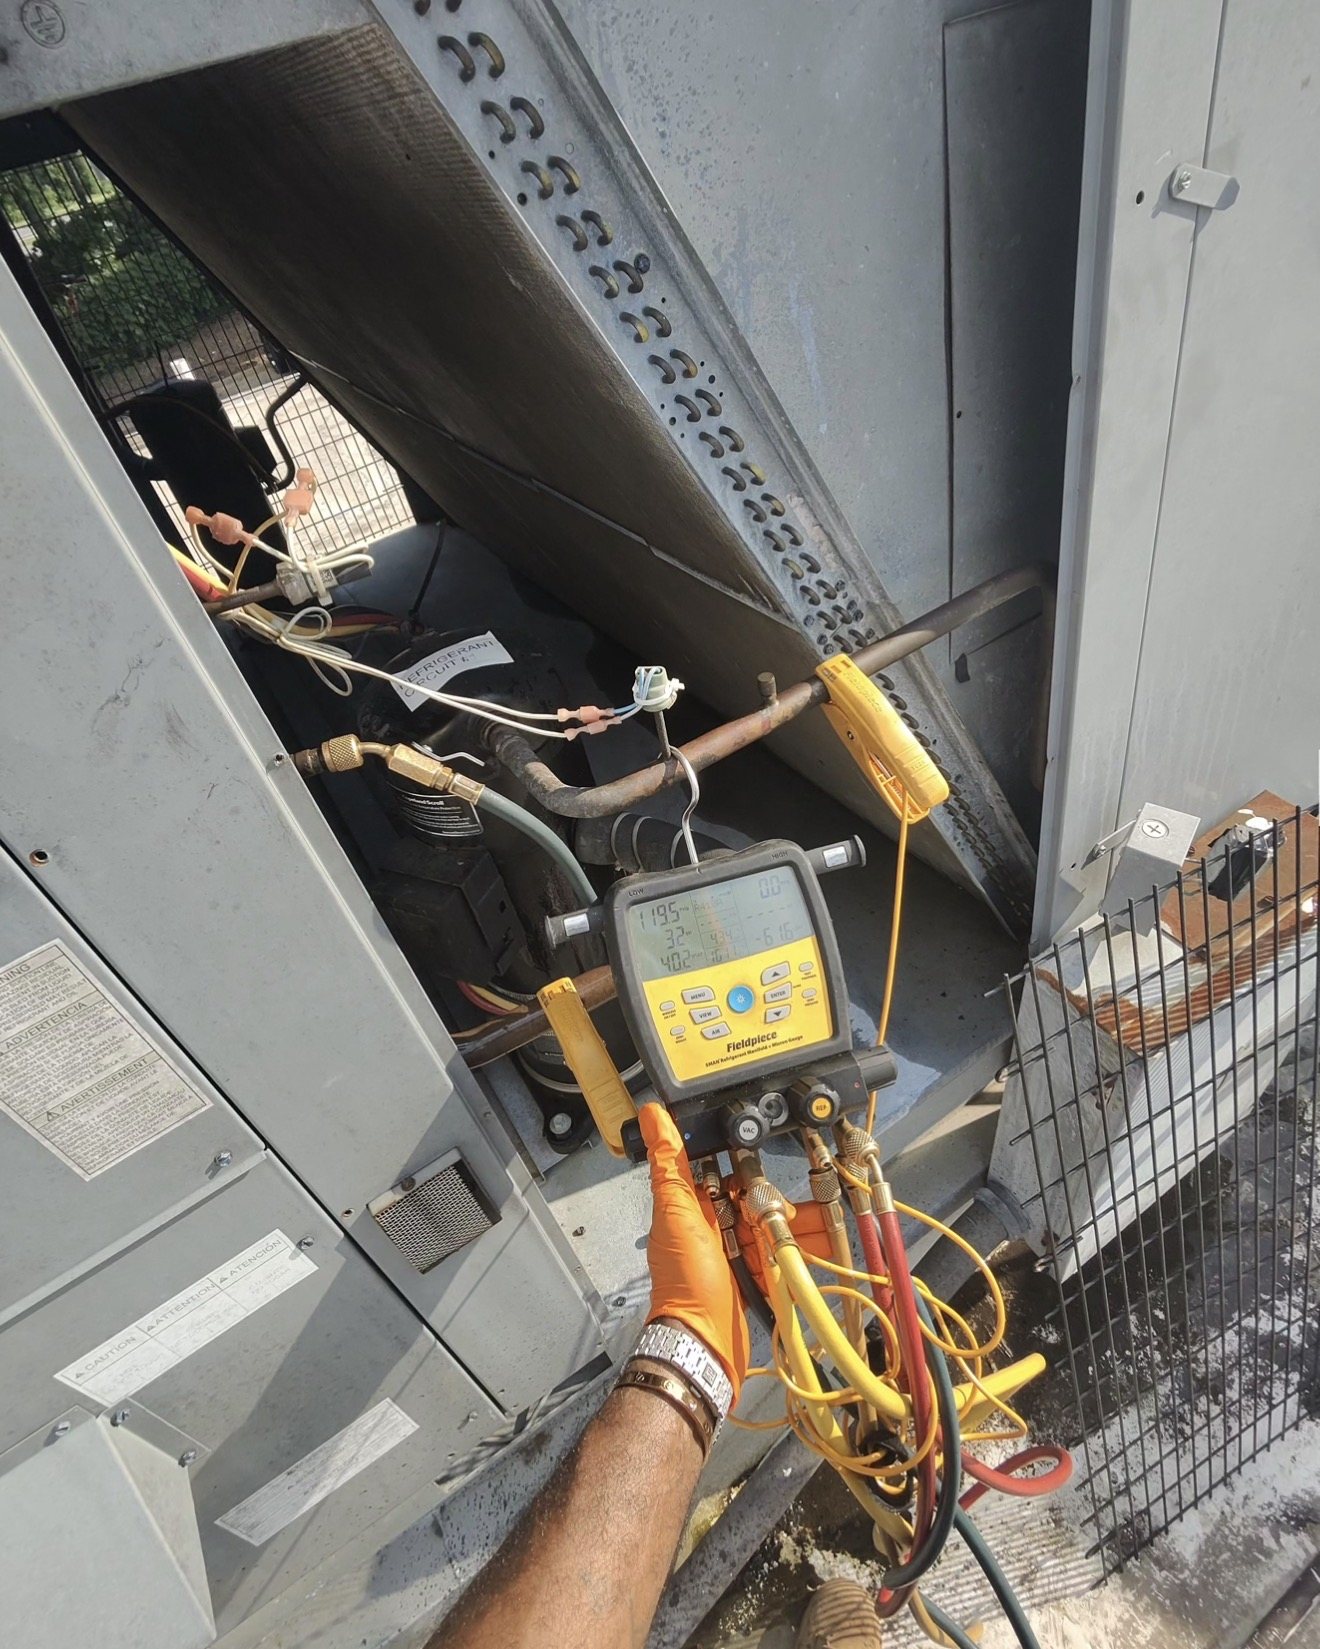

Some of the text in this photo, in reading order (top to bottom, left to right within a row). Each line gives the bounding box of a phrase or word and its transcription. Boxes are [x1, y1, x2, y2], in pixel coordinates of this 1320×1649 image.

[404, 661, 457, 698] CRCUIT
[771, 851, 789, 860] HIGH
[628, 888, 644, 897] LOW
[3, 1000, 87, 1049] ADVERTENCIA
[726, 1031, 777, 1053] Fieldpiece
[58, 1058, 148, 1112] AVERTISSEMENT
[742, 1126, 756, 1134] VAC
[229, 1239, 282, 1276] ATENCIÓN
[155, 1283, 216, 1326] ATTENTION
[84, 1336, 137, 1372] CAUTION
